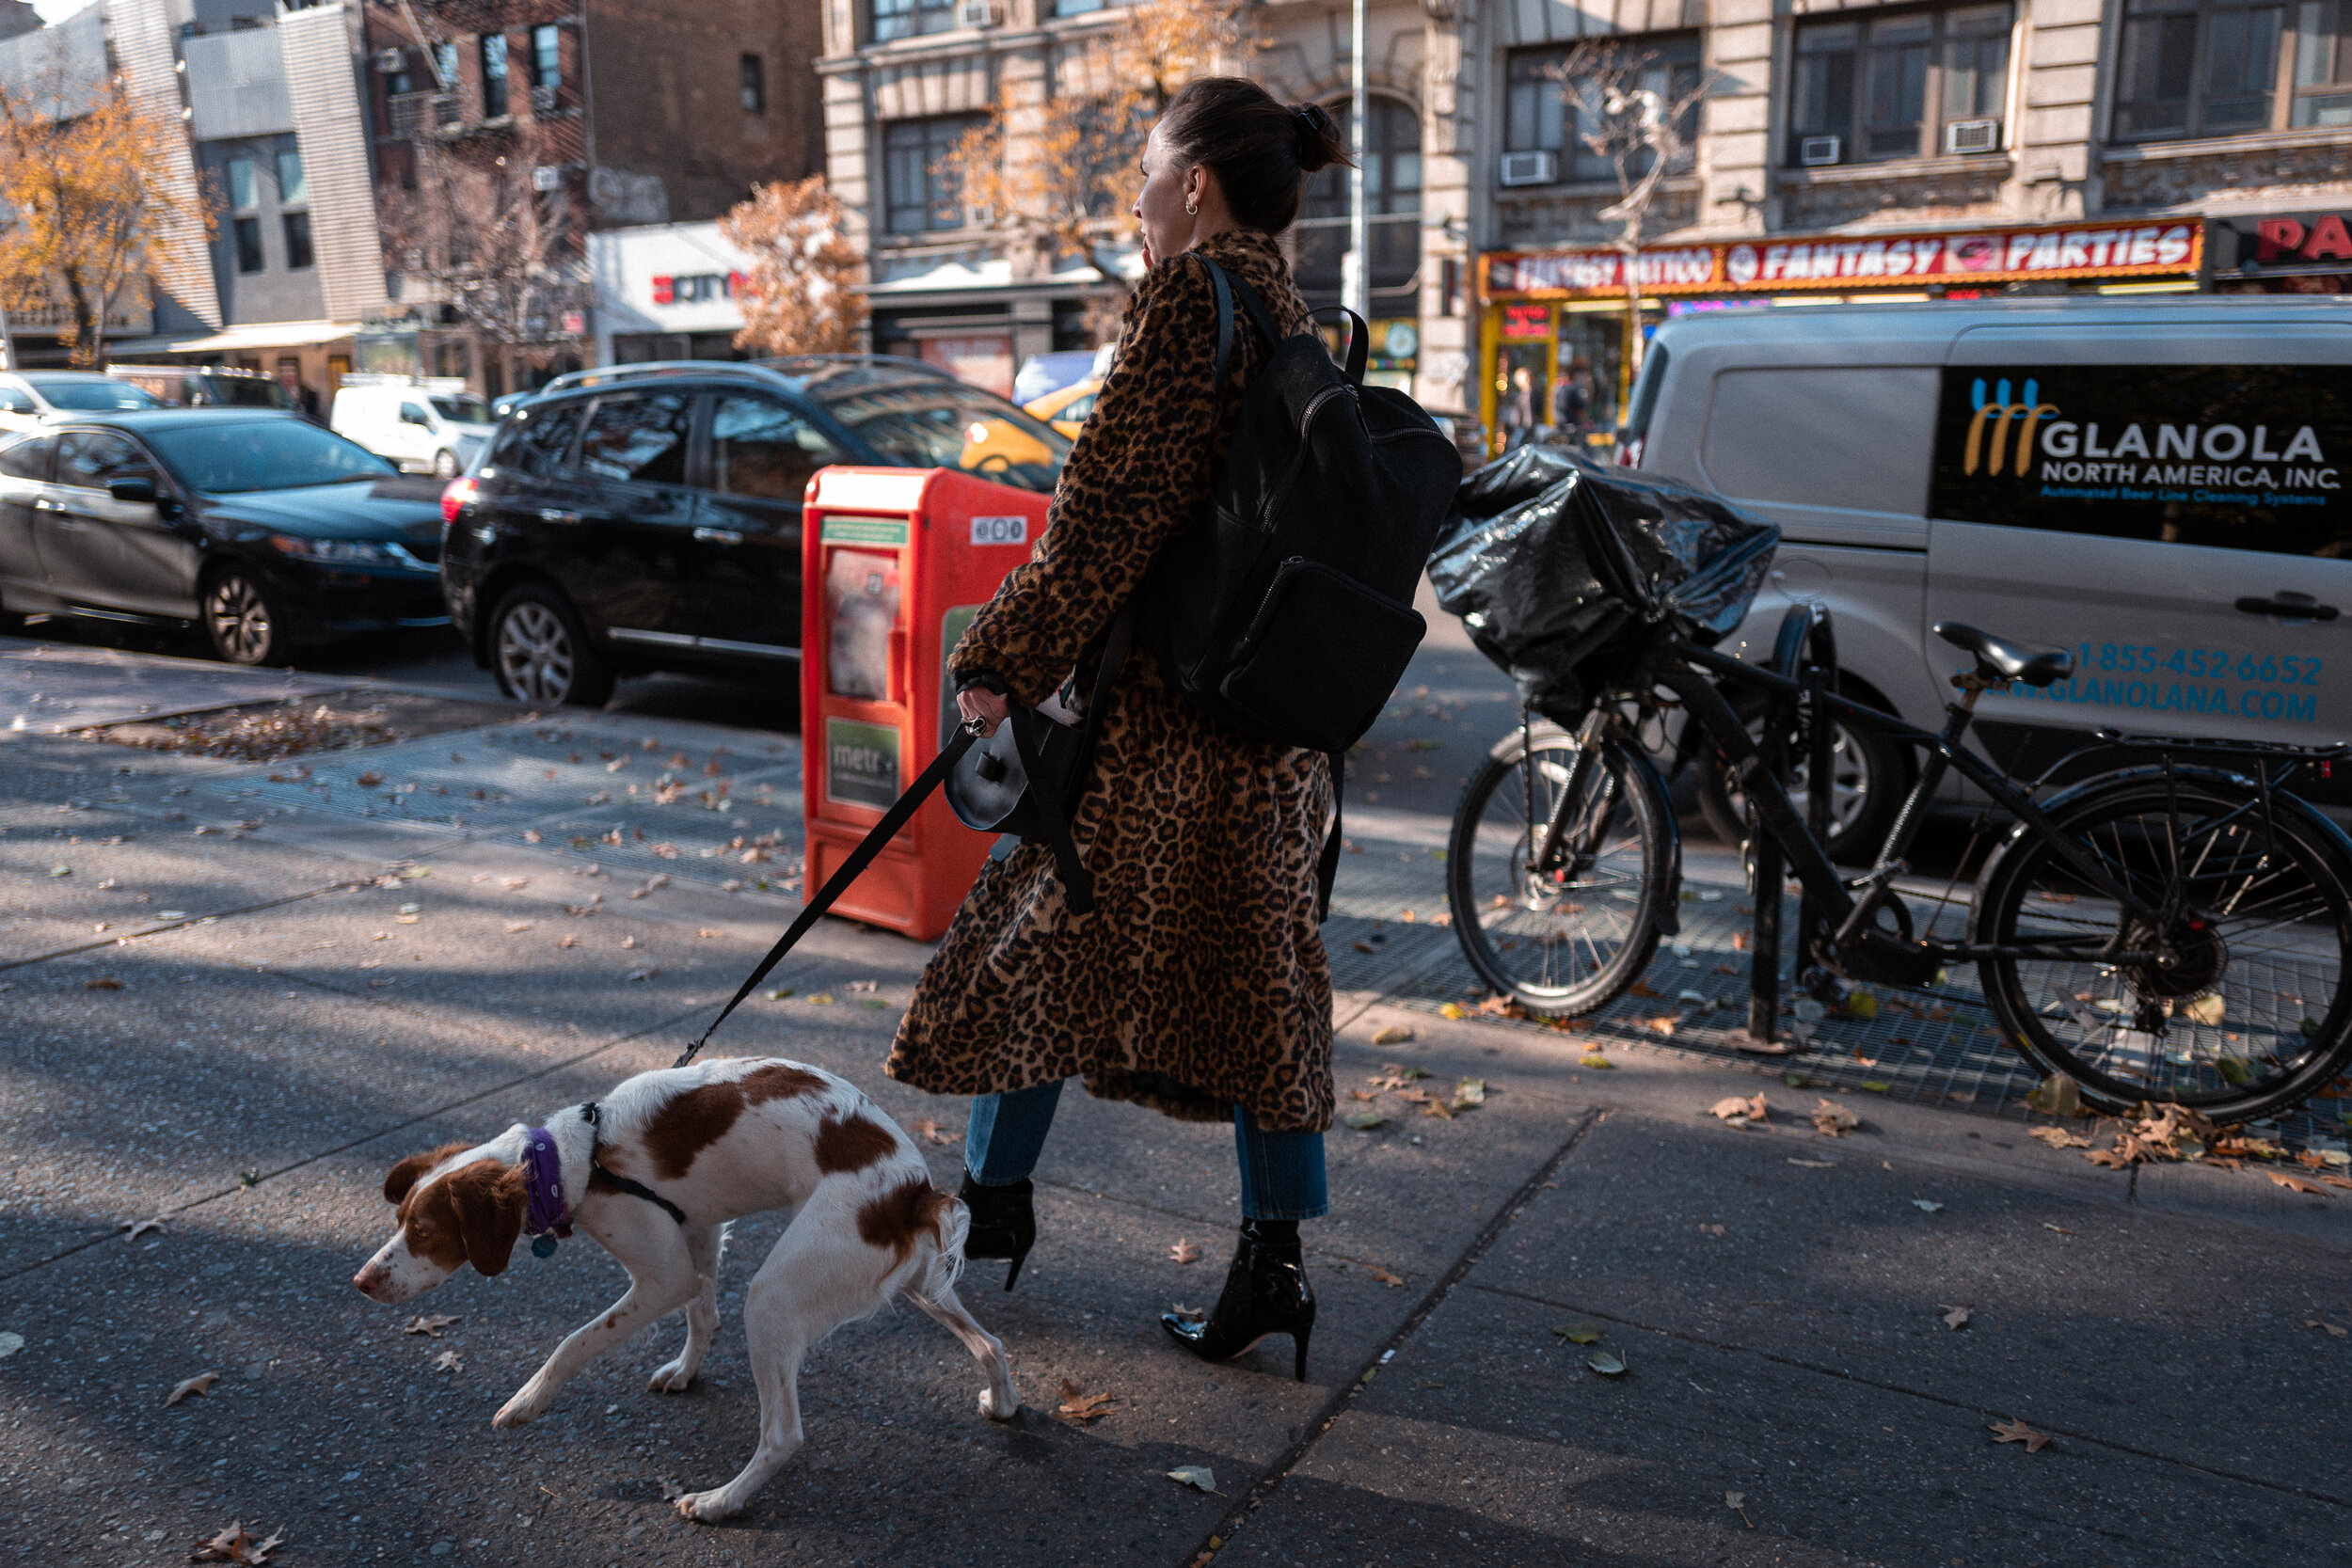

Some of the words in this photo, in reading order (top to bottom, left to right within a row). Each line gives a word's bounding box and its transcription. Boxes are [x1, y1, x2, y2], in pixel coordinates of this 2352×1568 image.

[1763, 238, 1947, 280] FANTASY
[2005, 225, 2191, 272] PARTIES
[2041, 420, 2326, 463] GLANOLA
[2039, 483, 2118, 500] Automated
[2121, 485, 2155, 501] Beer
[2157, 488, 2189, 502] Line
[2192, 488, 2260, 507] Cleaning
[2263, 490, 2327, 508] Systems
[2041, 460, 2137, 484] NORTH
[2140, 463, 2280, 490] AMERICA,
[2077, 641, 2324, 687] 1-855-452-6652
